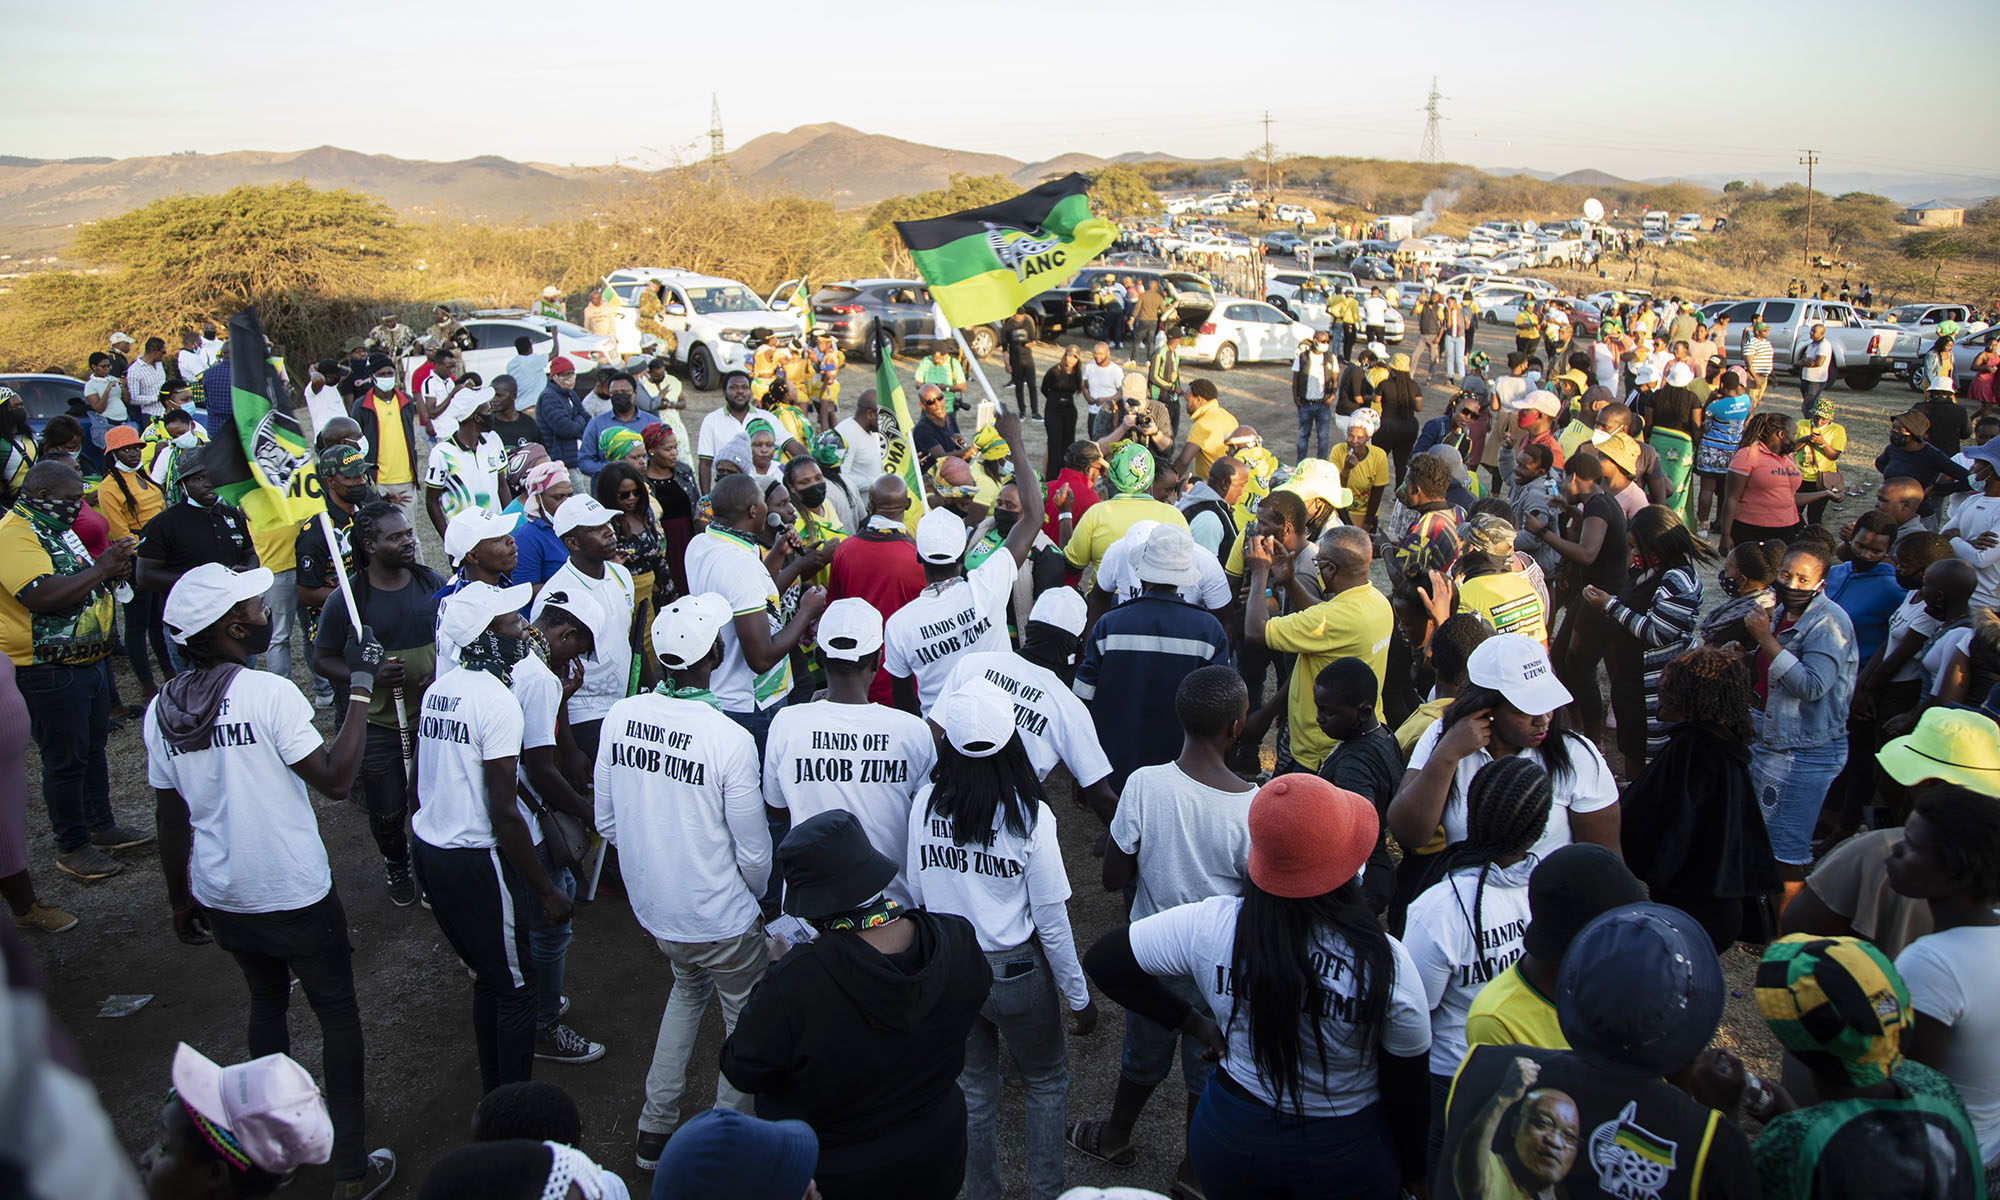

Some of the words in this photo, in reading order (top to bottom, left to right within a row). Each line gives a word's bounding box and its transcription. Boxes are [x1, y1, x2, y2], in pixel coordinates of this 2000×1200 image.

[1025, 250, 1066, 279] ANC
[287, 471, 322, 498] NC
[920, 617, 956, 640] HANDS
[956, 607, 977, 626] OFF
[915, 636, 961, 666] JACOB
[962, 616, 993, 647] ZUMA
[984, 669, 1020, 696] HANDS
[1020, 685, 1045, 703] OFF
[625, 719, 666, 745] HANDS
[668, 731, 693, 751] OFF
[812, 731, 858, 752] HANDS
[862, 733, 890, 752] OFF
[611, 742, 661, 773] JACOB
[664, 754, 705, 786] ZUMA
[795, 757, 853, 785] JACOB
[860, 759, 908, 784] ZUMA
[920, 844, 968, 873] JACOB
[973, 851, 1022, 878] ZUMA
[1310, 951, 1347, 982] OFF
